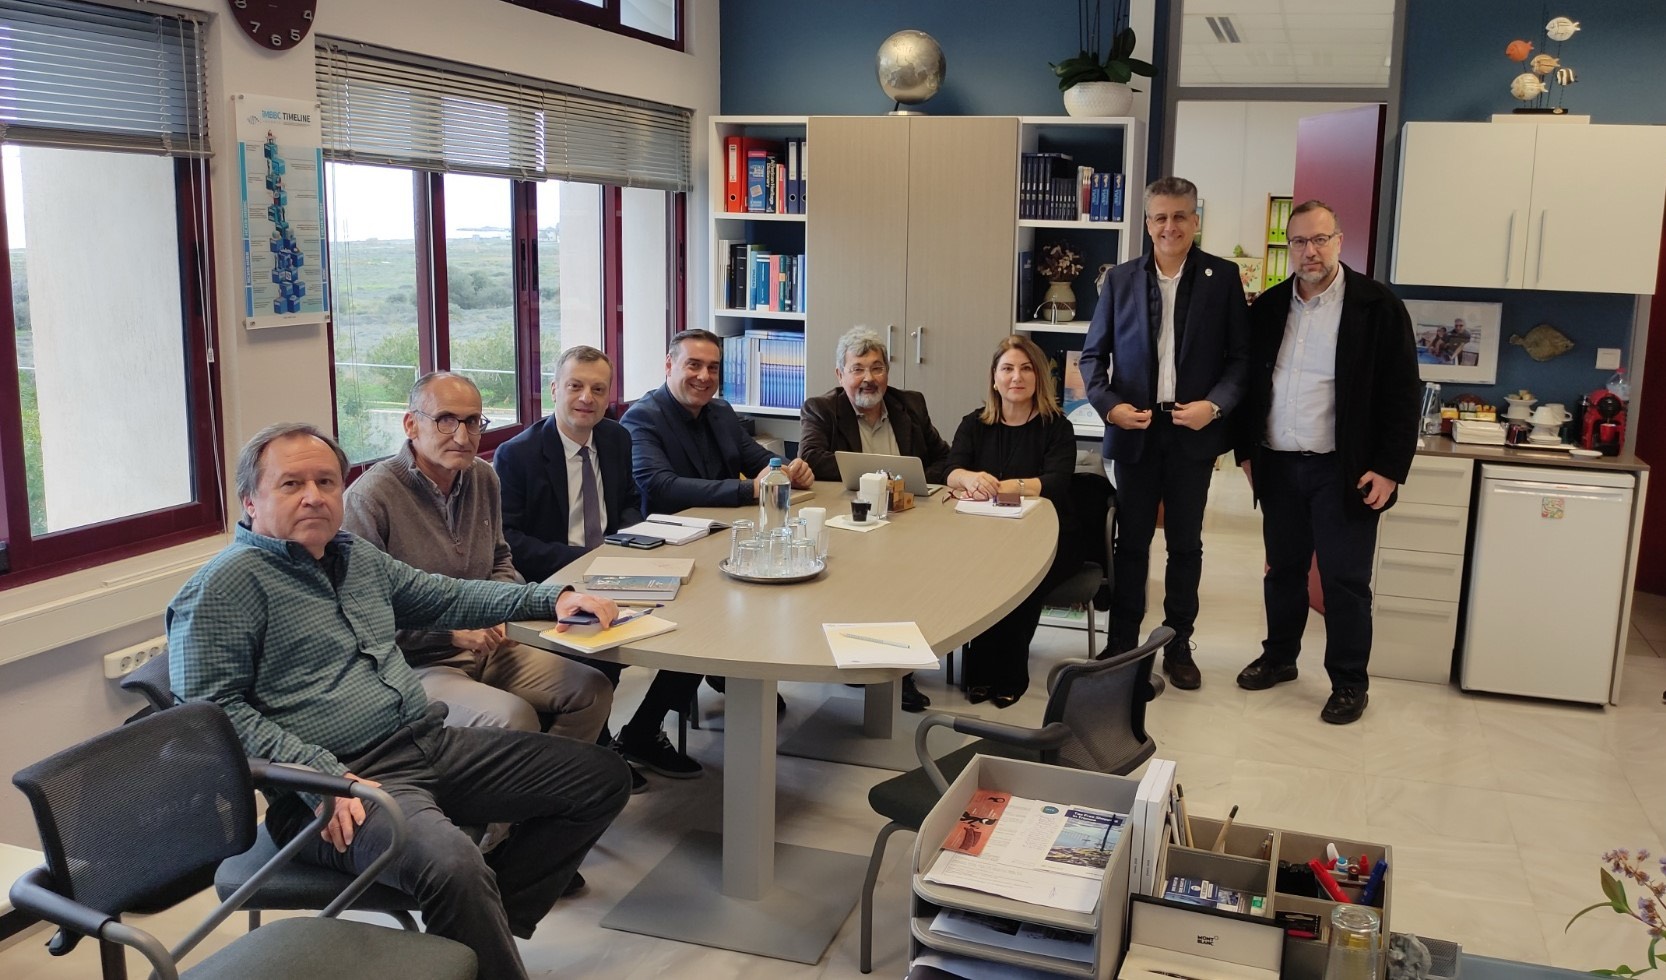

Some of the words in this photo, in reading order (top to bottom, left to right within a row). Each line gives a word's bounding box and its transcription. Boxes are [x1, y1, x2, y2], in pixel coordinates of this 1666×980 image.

[303, 10, 313, 21] 4
[250, 21, 261, 33] 7
[271, 34, 282, 46] 6
[290, 28, 301, 41] 5
[282, 112, 311, 122] TIMELINE
